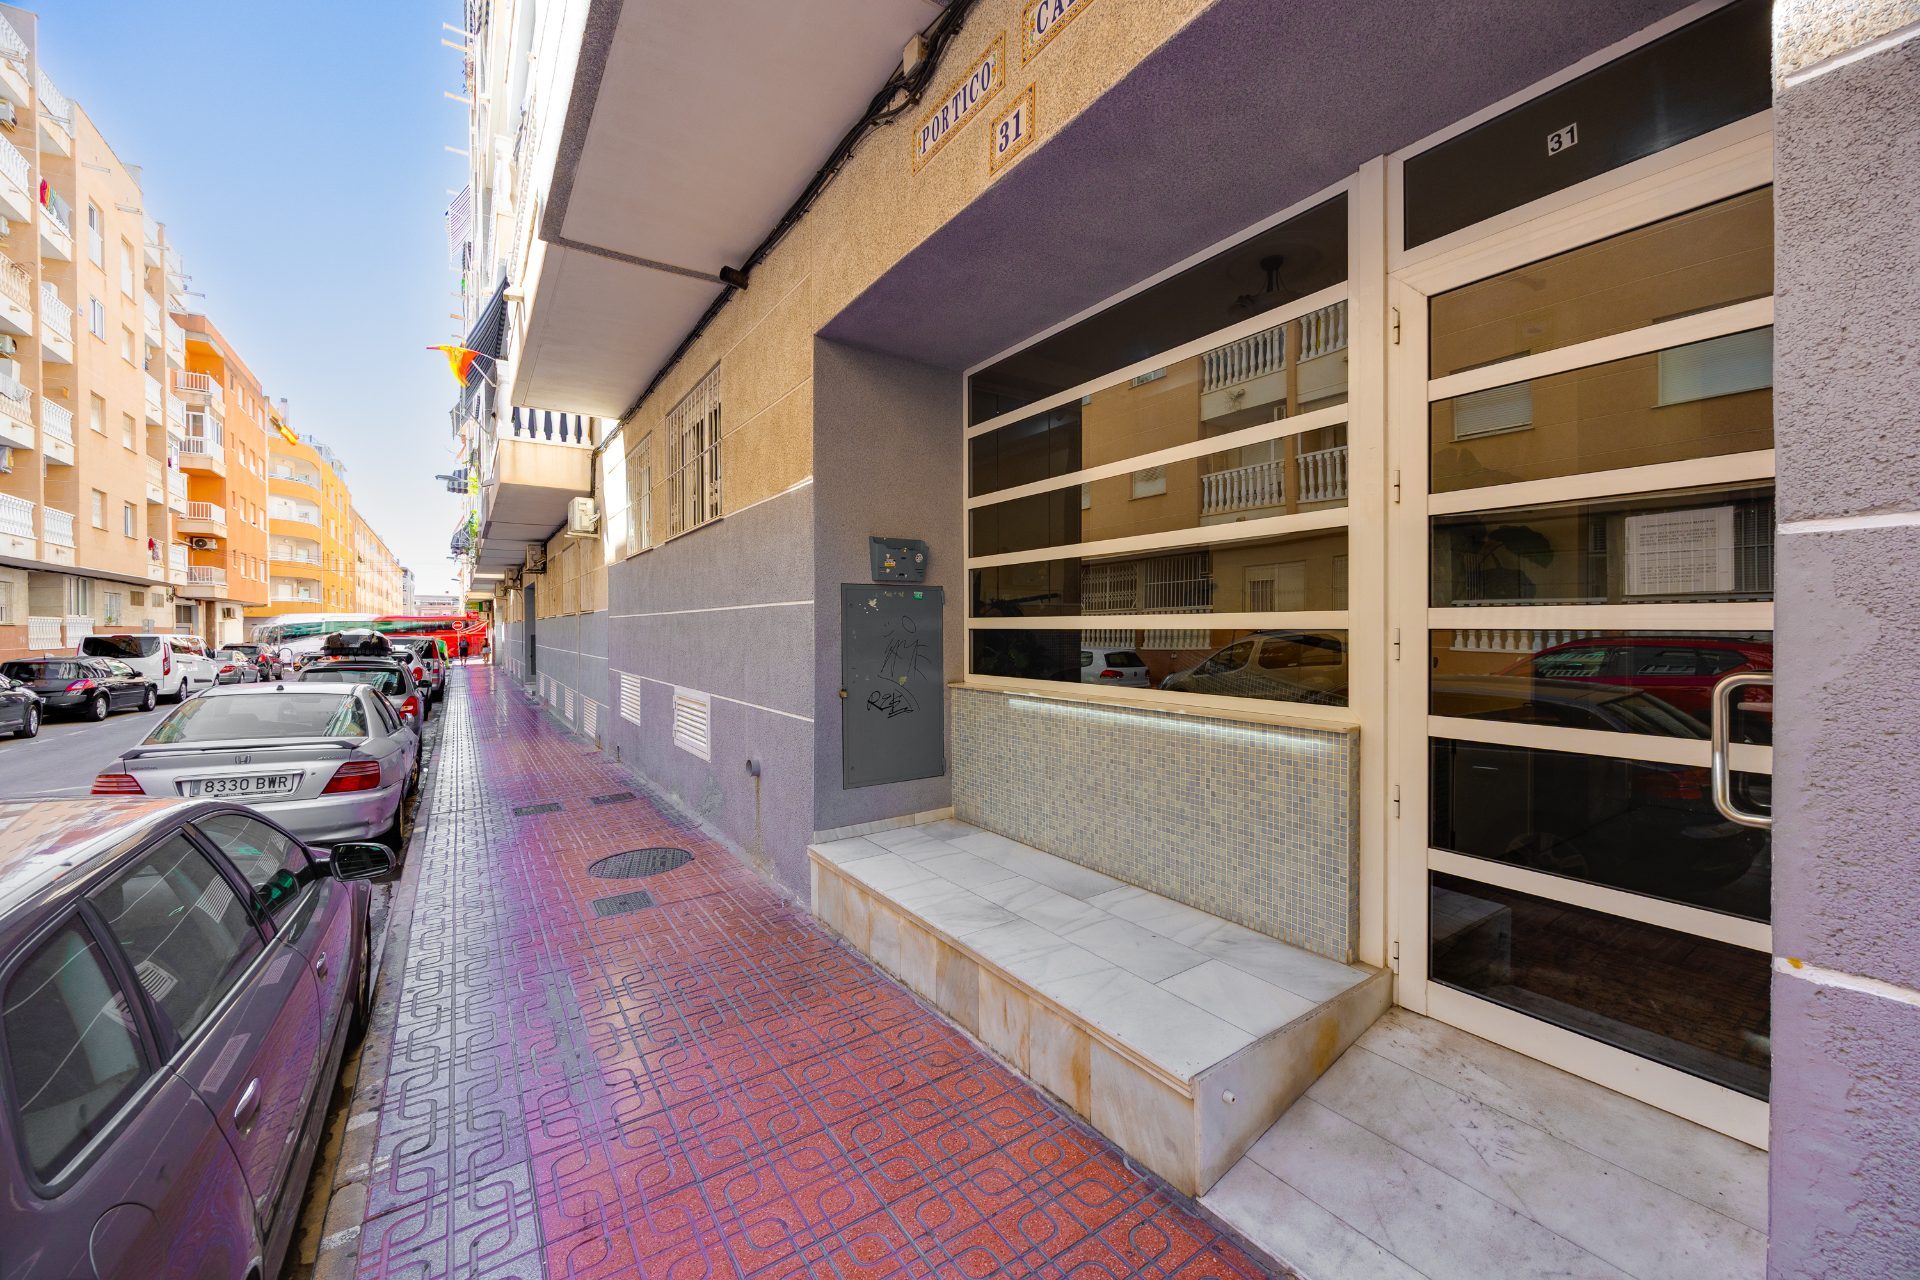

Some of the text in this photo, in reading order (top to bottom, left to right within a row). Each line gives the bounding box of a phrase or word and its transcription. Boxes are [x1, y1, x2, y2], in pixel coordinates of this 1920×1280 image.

[1037, 0, 1075, 34] CA
[921, 61, 991, 154] PORTICO
[999, 109, 1022, 153] 31
[1550, 126, 1575, 153] 31
[205, 779, 250, 793] 8330
[256, 776, 288, 790] BWR
